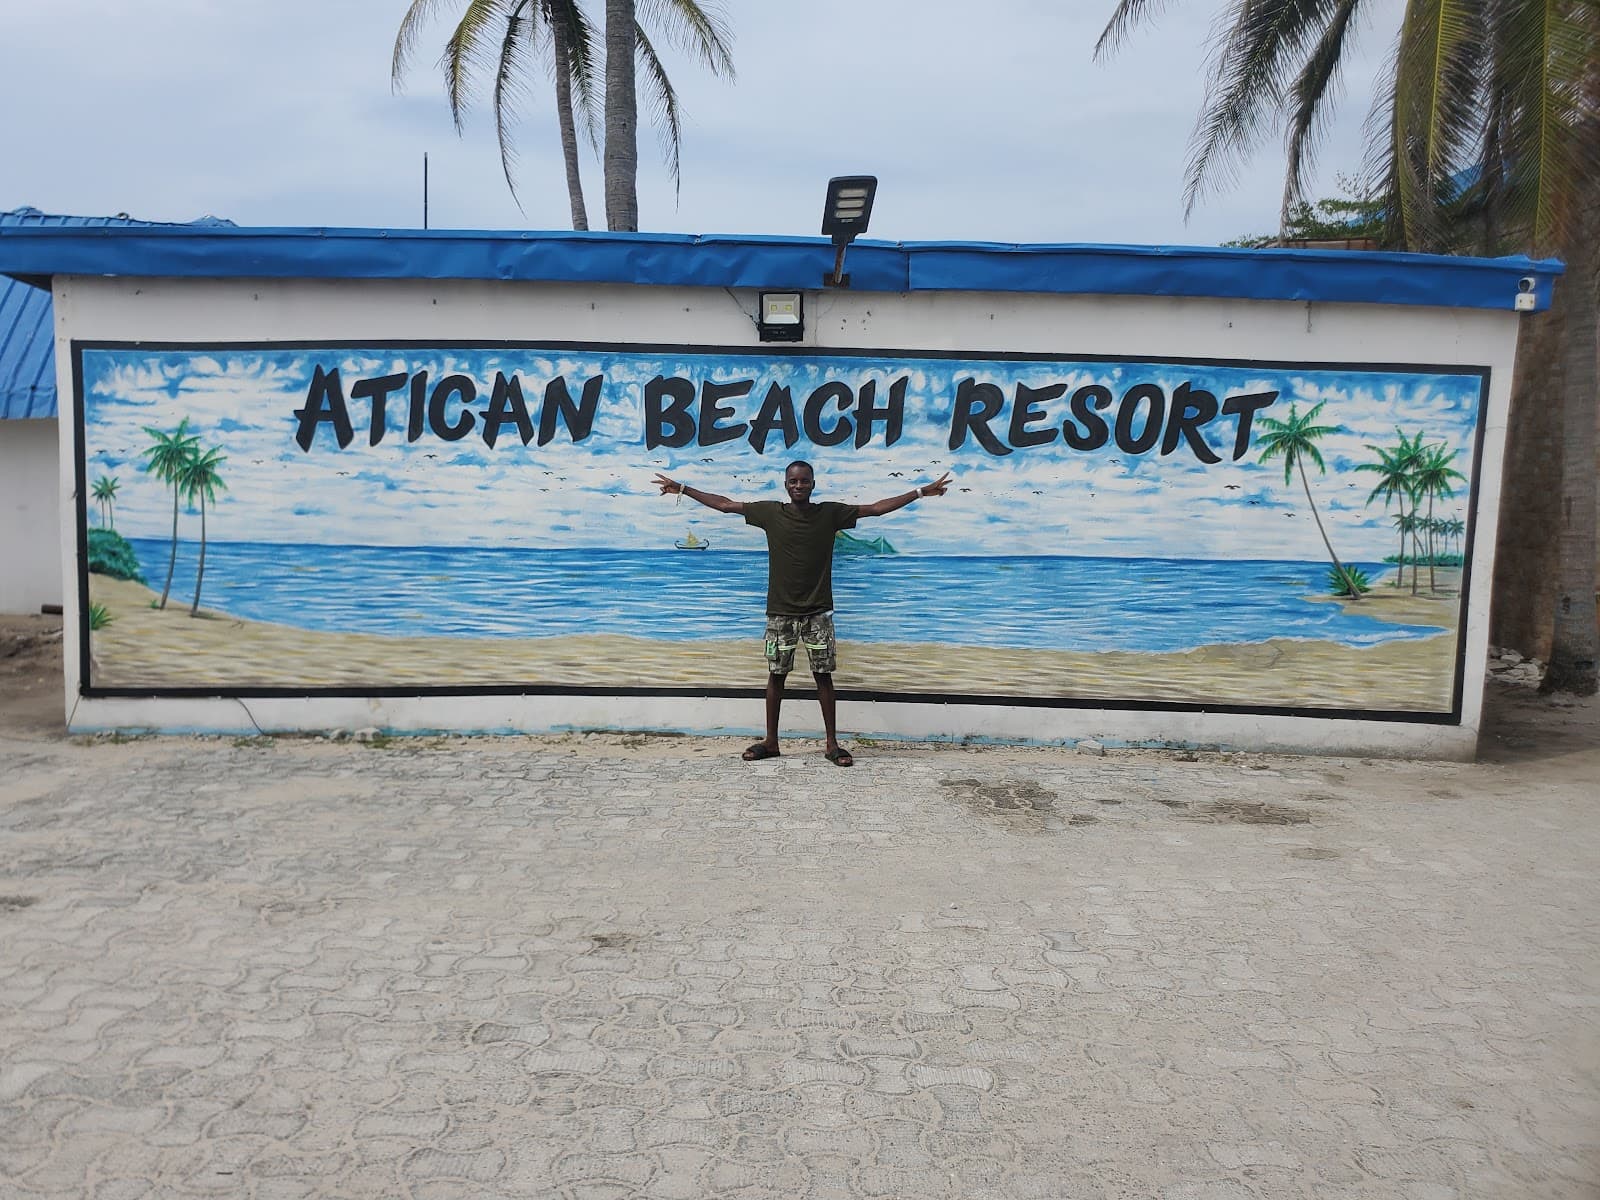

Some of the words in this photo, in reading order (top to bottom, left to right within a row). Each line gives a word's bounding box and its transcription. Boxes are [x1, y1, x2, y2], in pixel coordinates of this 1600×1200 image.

[294, 364, 604, 453] ATICAN
[644, 375, 909, 455] BEACH
[948, 377, 1279, 465] RESORT
